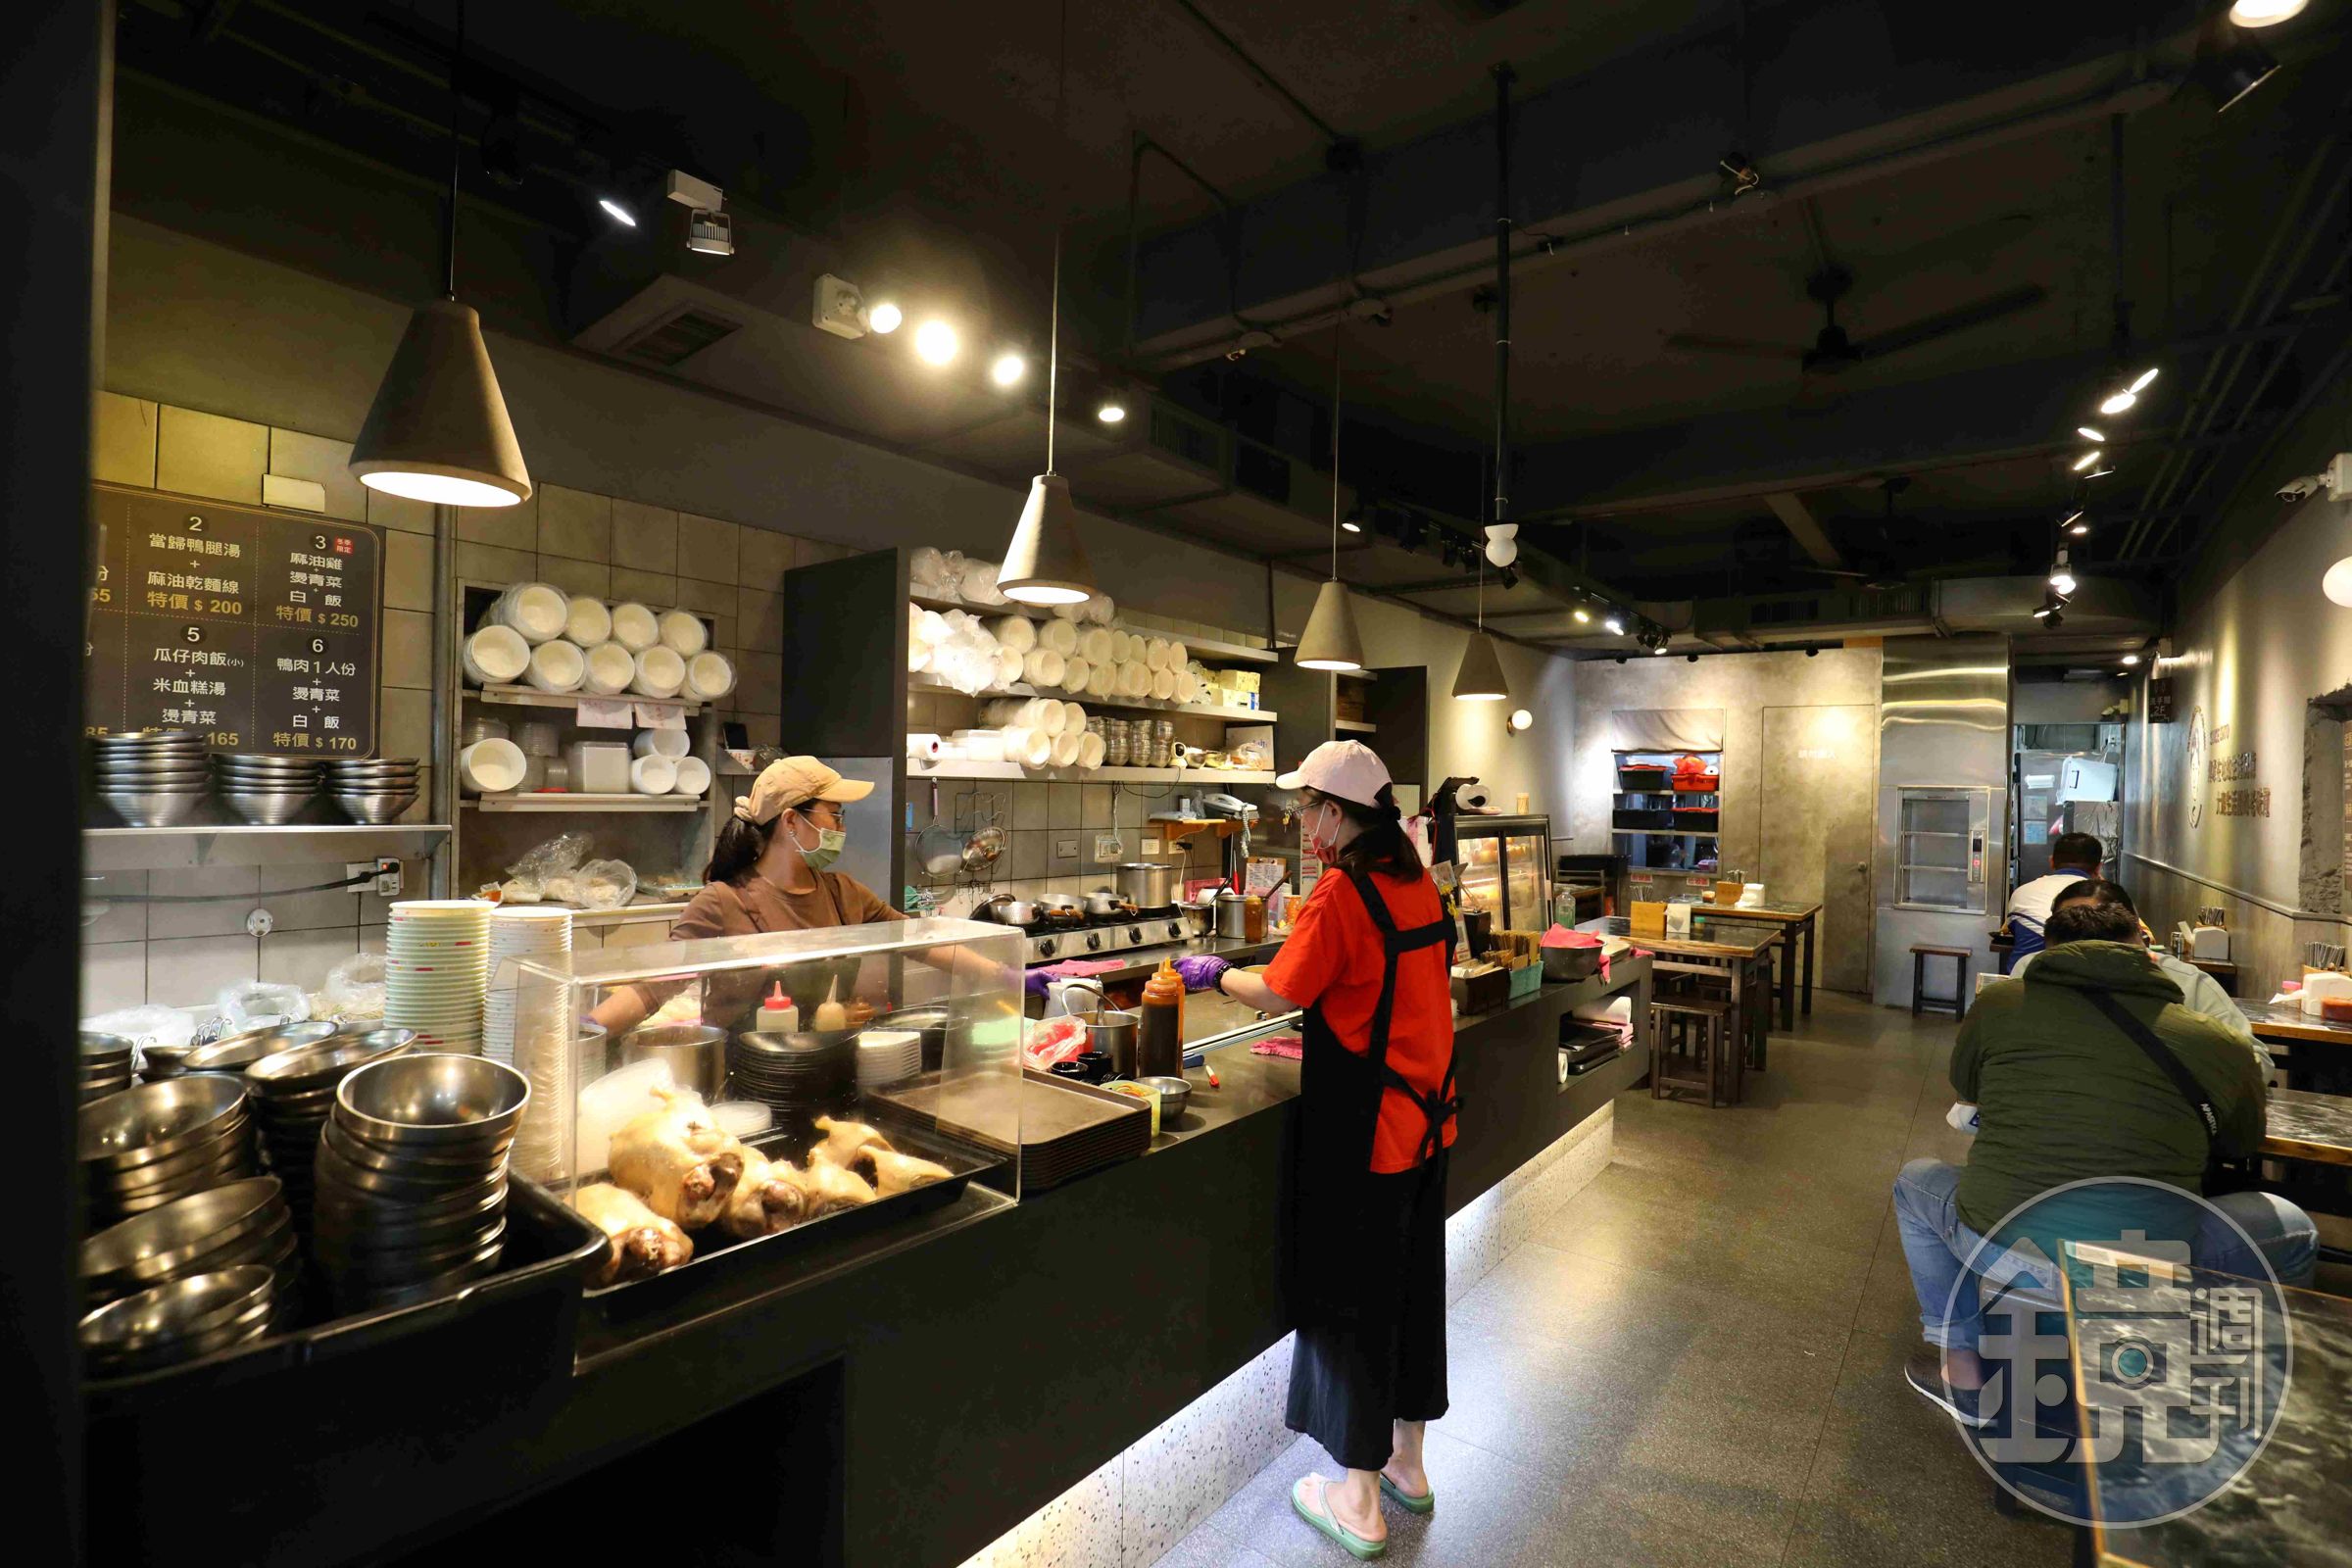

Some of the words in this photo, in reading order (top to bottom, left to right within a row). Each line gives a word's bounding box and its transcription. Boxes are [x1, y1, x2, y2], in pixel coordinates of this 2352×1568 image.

[188, 516, 203, 531] 2
[149, 533, 241, 559] 當歸鴨腿湯
[316, 535, 326, 549] 3
[290, 553, 343, 570] 麻油雞
[147, 571, 239, 594] 麻油乾麵線
[290, 570, 342, 588] 燙青菜
[147, 592, 188, 611] 特價
[210, 600, 242, 615] 200
[276, 605, 312, 623] 特價
[330, 612, 359, 627] 250
[187, 627, 200, 642] 5
[313, 639, 323, 653] 6
[153, 677, 226, 696] 米血糕湯
[293, 686, 340, 702] 燙青菜
[162, 709, 217, 725] 燙青菜
[208, 732, 238, 745] 165
[273, 732, 310, 748] 特價
[329, 737, 357, 750] 170
